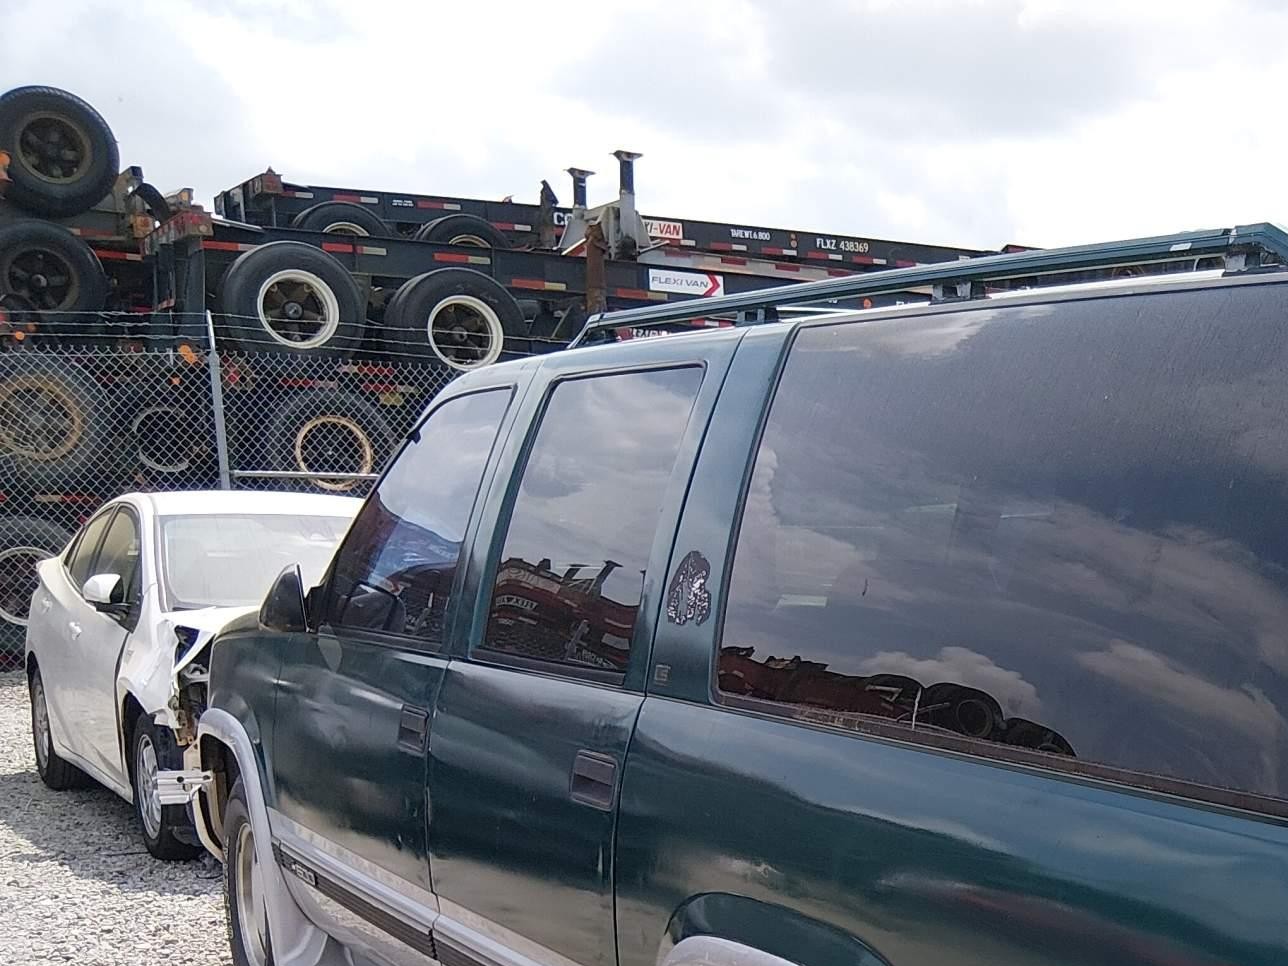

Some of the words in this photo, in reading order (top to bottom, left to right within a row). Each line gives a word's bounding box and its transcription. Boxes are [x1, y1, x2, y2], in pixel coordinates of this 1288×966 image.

[816, 238, 837, 250] FLXZ
[839, 240, 869, 253] 438369
[651, 276, 683, 286] FLEXI
[685, 279, 709, 288] VAN
